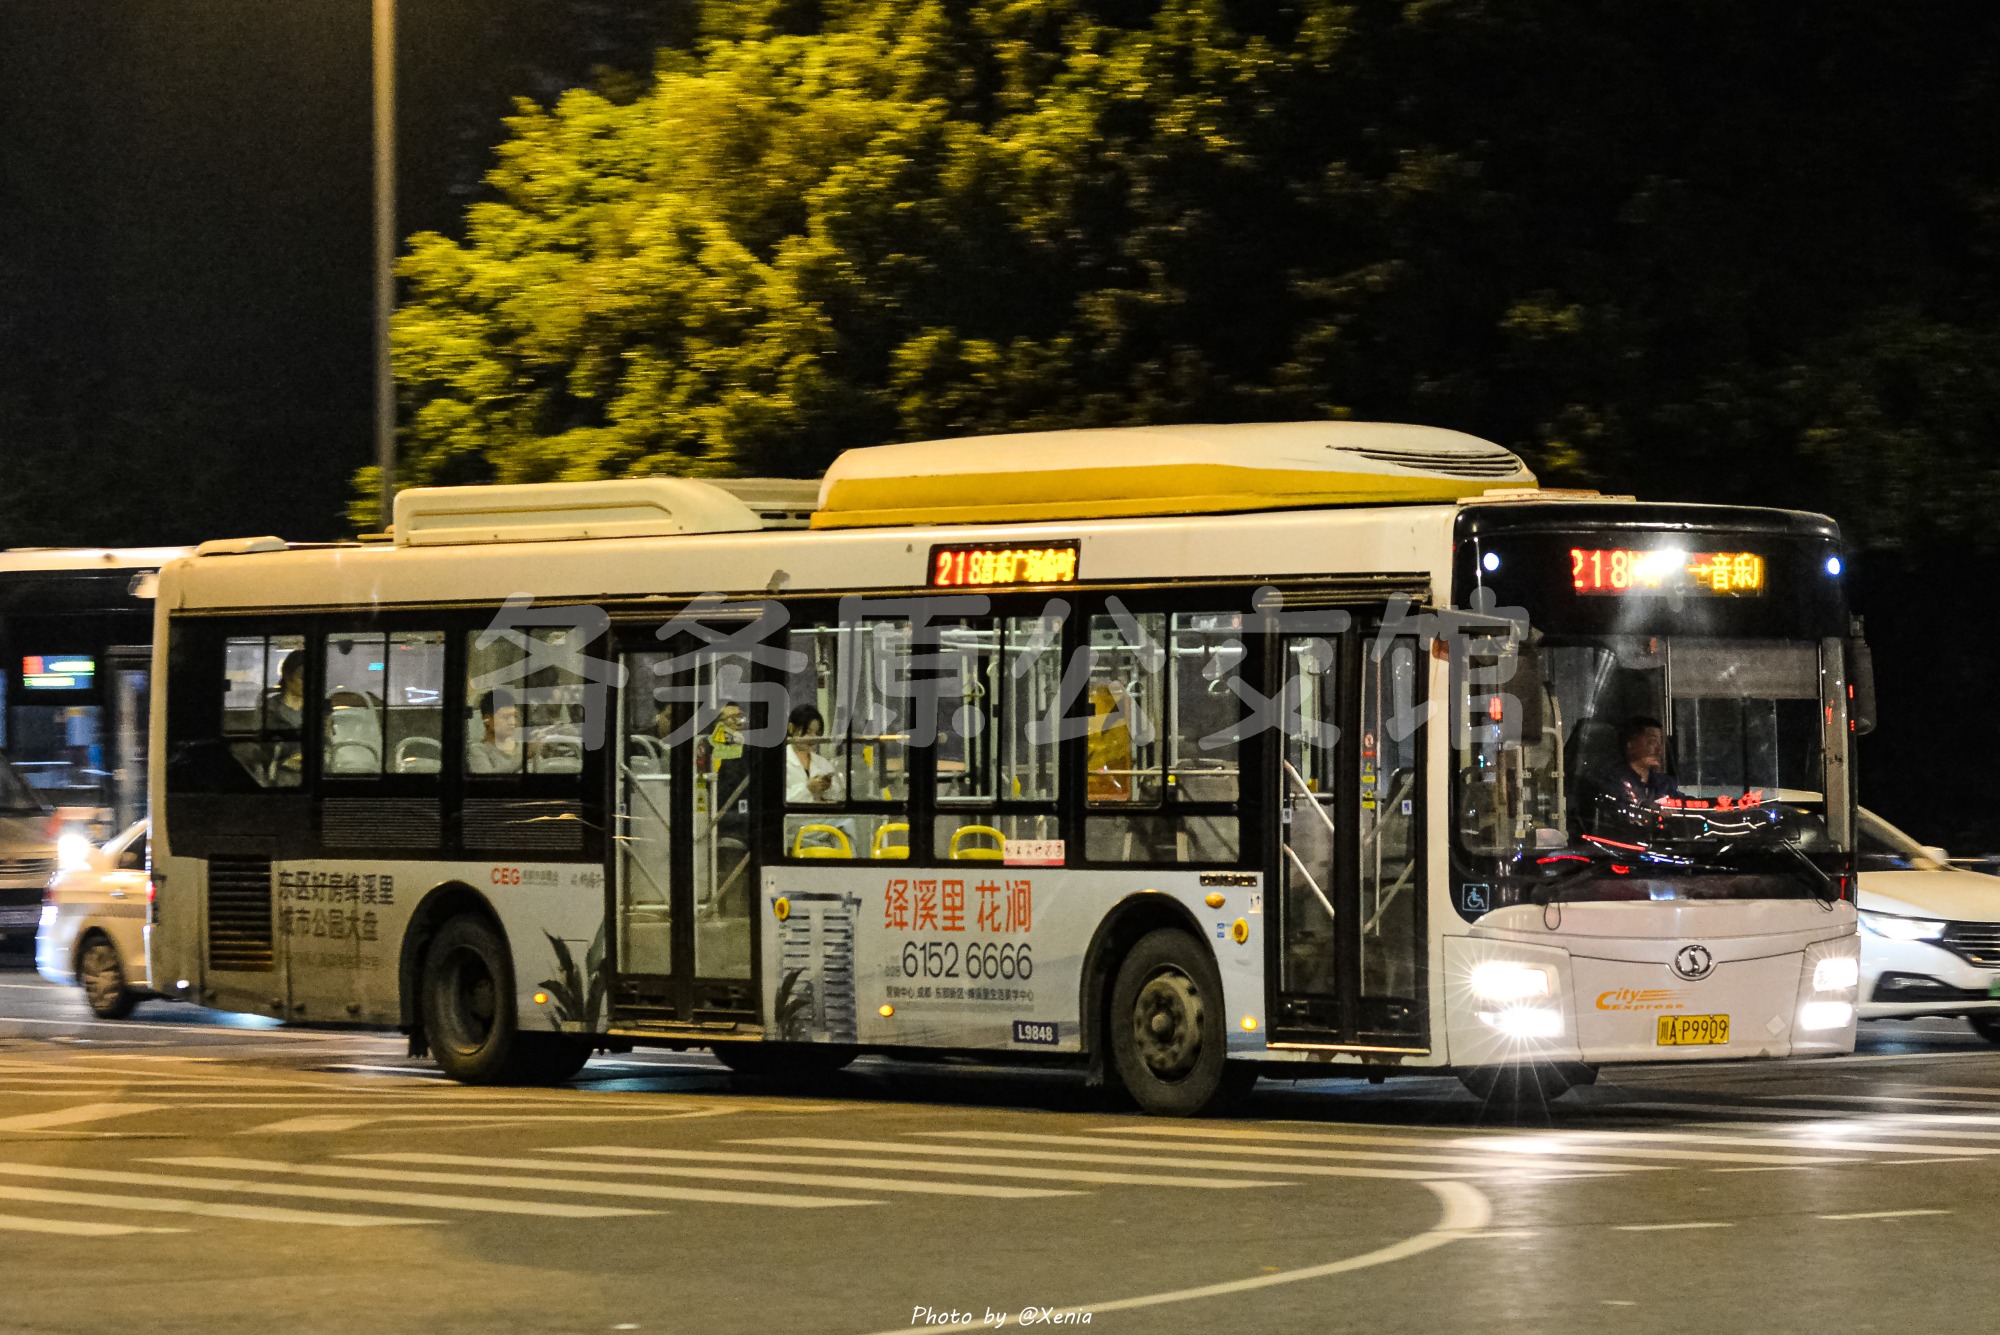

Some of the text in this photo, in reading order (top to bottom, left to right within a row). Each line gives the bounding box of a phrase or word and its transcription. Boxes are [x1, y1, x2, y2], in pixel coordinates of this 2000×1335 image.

[937, 550, 982, 585] 218
[1571, 549, 1628, 588] 218
[490, 867, 520, 886] CEG
[902, 940, 960, 978] 6152
[966, 942, 1033, 980] 6666
[1018, 1024, 1053, 1042] L9848
